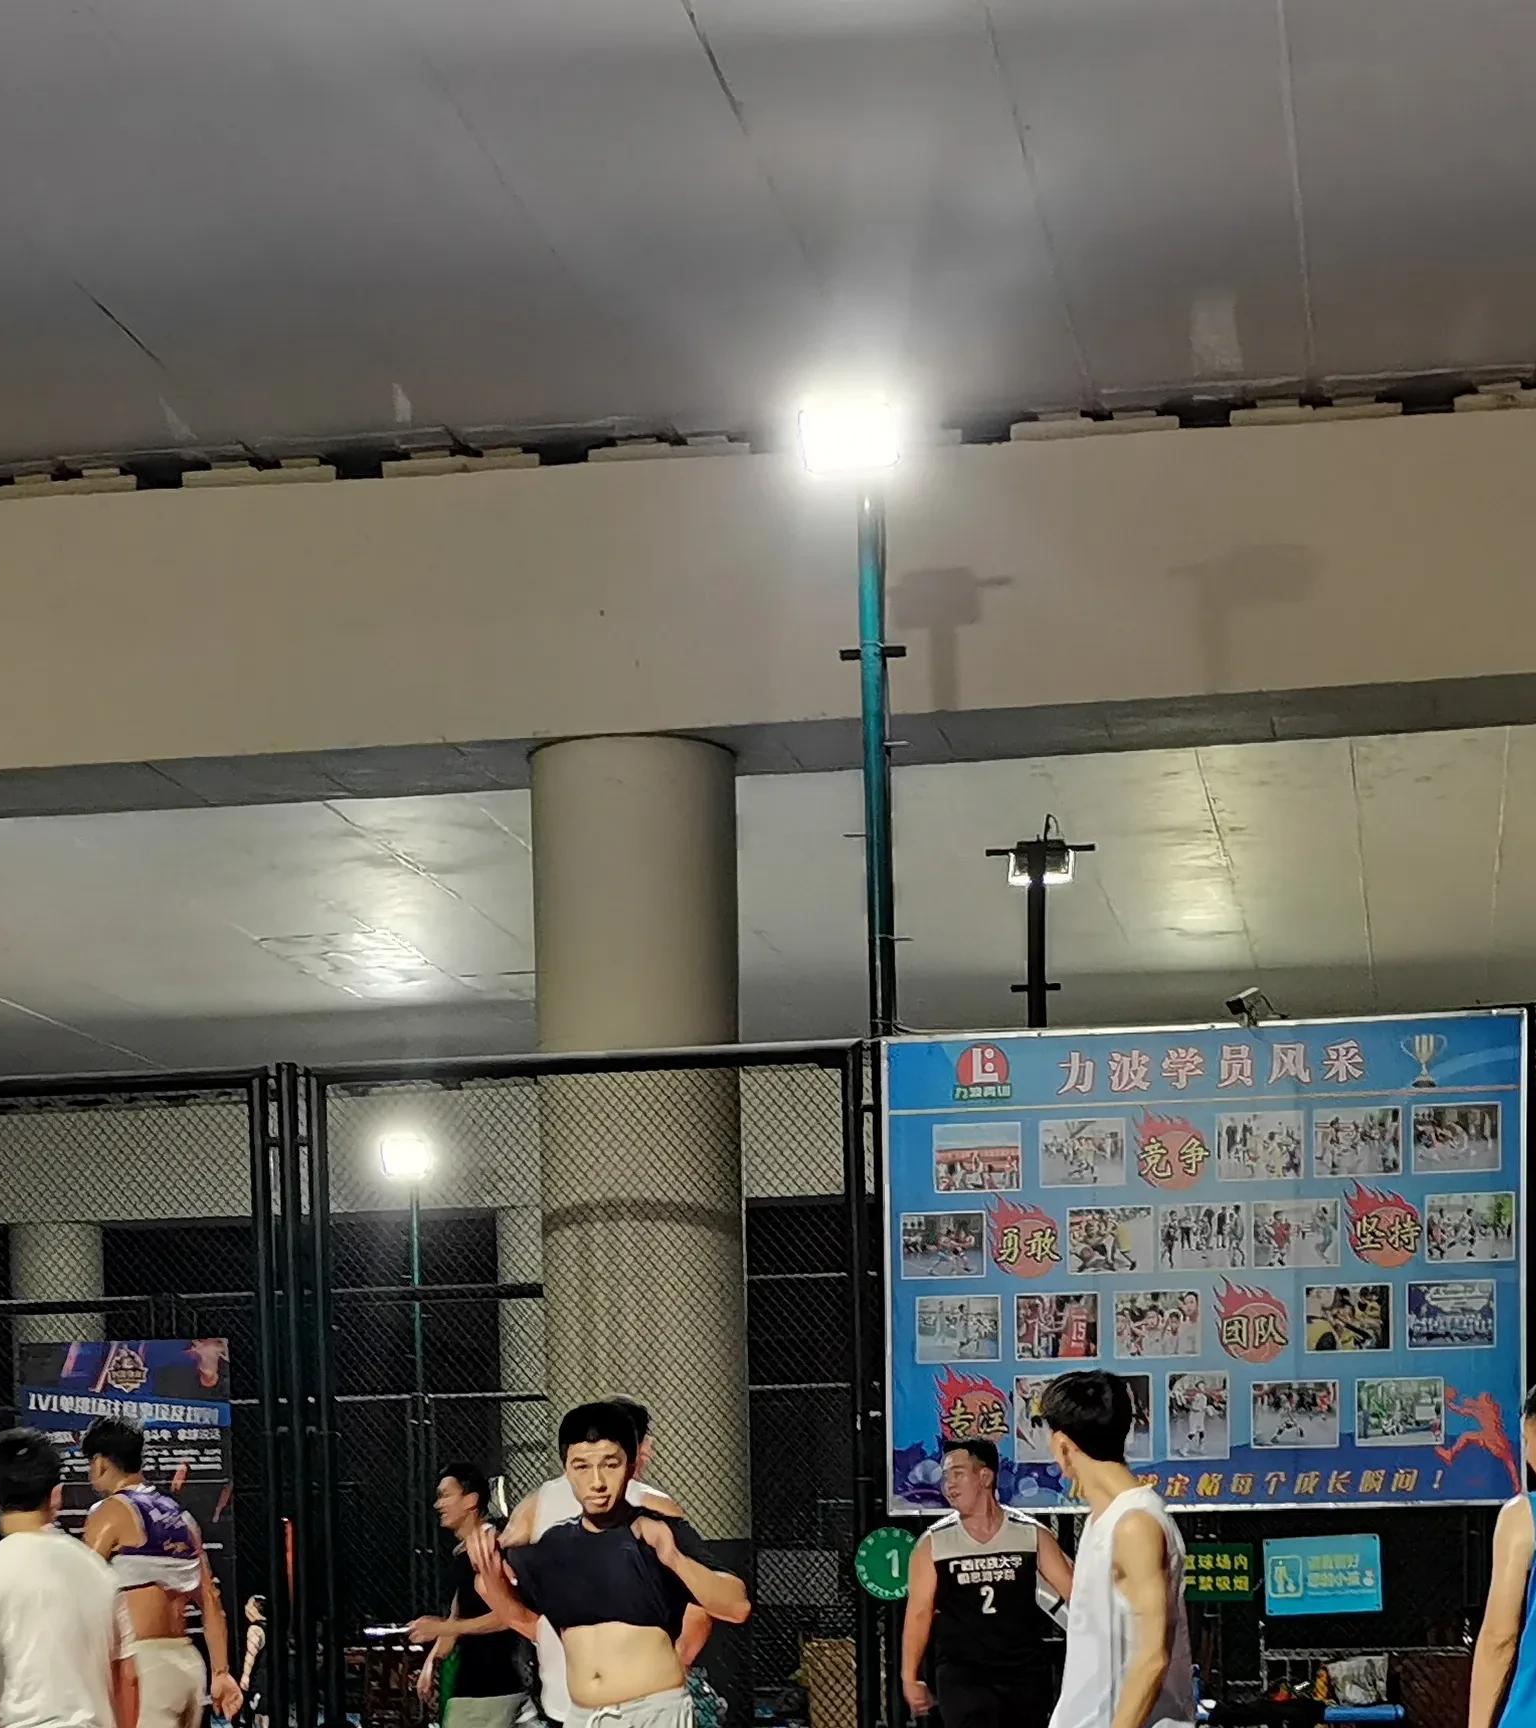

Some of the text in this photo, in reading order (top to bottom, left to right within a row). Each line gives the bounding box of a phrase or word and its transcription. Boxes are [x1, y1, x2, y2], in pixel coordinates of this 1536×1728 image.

[1057, 1040, 1365, 1095] 力波学员风采
[1139, 1137, 1210, 1179] 竞争
[997, 1226, 1063, 1264] 勇敢
[1355, 1214, 1423, 1251] 坚持
[1222, 1314, 1288, 1349] 团队
[943, 1398, 1009, 1437] 专注
[886, 1549, 900, 1578] 1
[980, 1585, 997, 1614] 2
